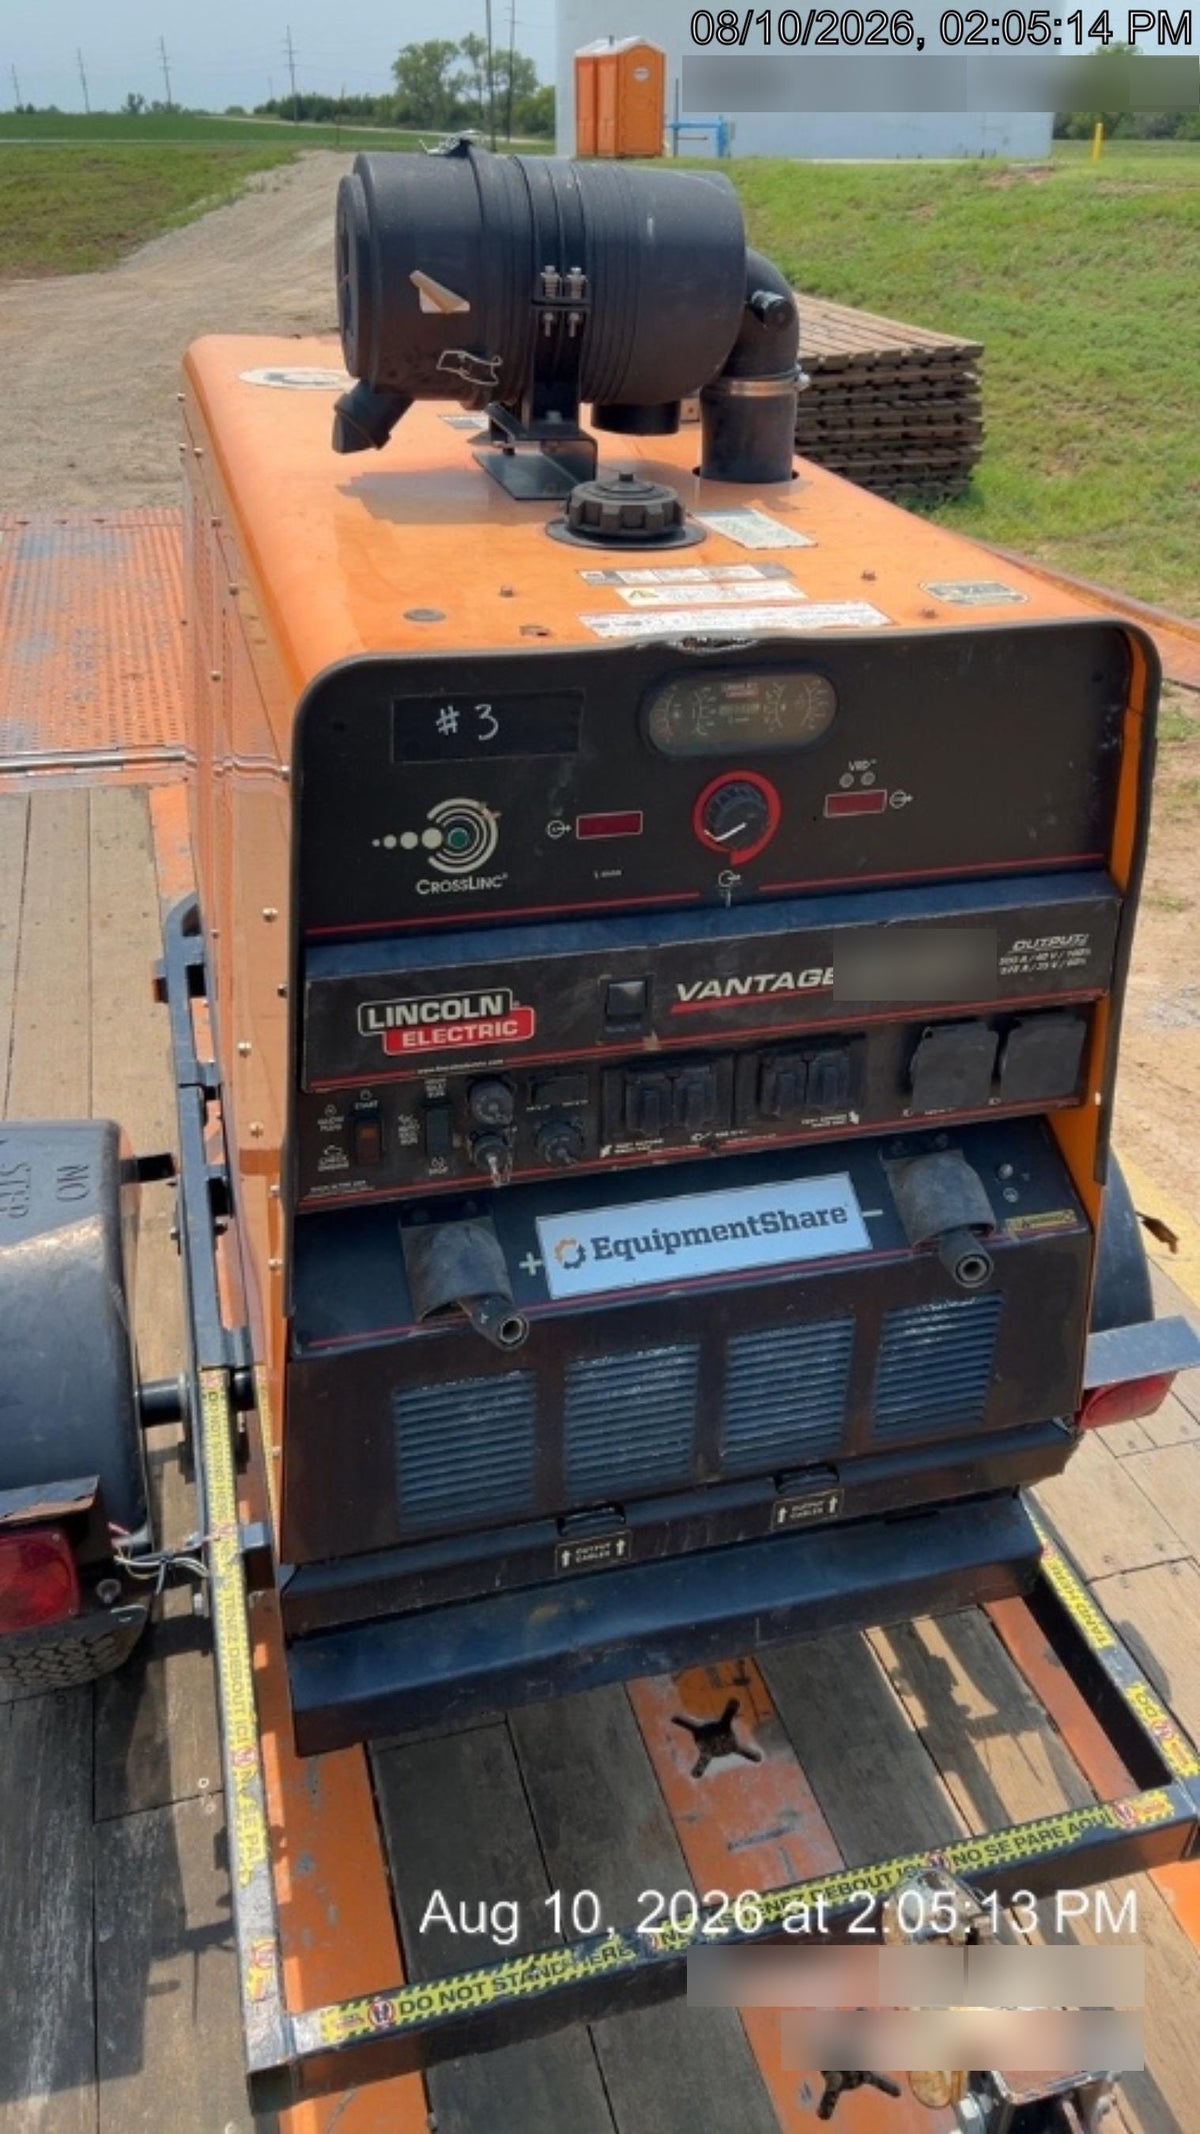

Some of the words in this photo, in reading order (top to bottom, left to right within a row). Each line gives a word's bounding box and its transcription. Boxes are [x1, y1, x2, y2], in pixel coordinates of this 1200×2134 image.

[435, 705, 460, 736] #
[474, 703, 499, 741] 3
[368, 994, 503, 1030] LINCOLN
[402, 1019, 519, 1048] ELECTRIC
[590, 1204, 849, 1262] EquipmentShare
[951, 1847, 982, 1867] NO
[985, 1841, 1011, 1859] SE
[1014, 1825, 1065, 1853] PARE
[400, 1995, 433, 2016] DO
[438, 1983, 486, 2009] NOT
